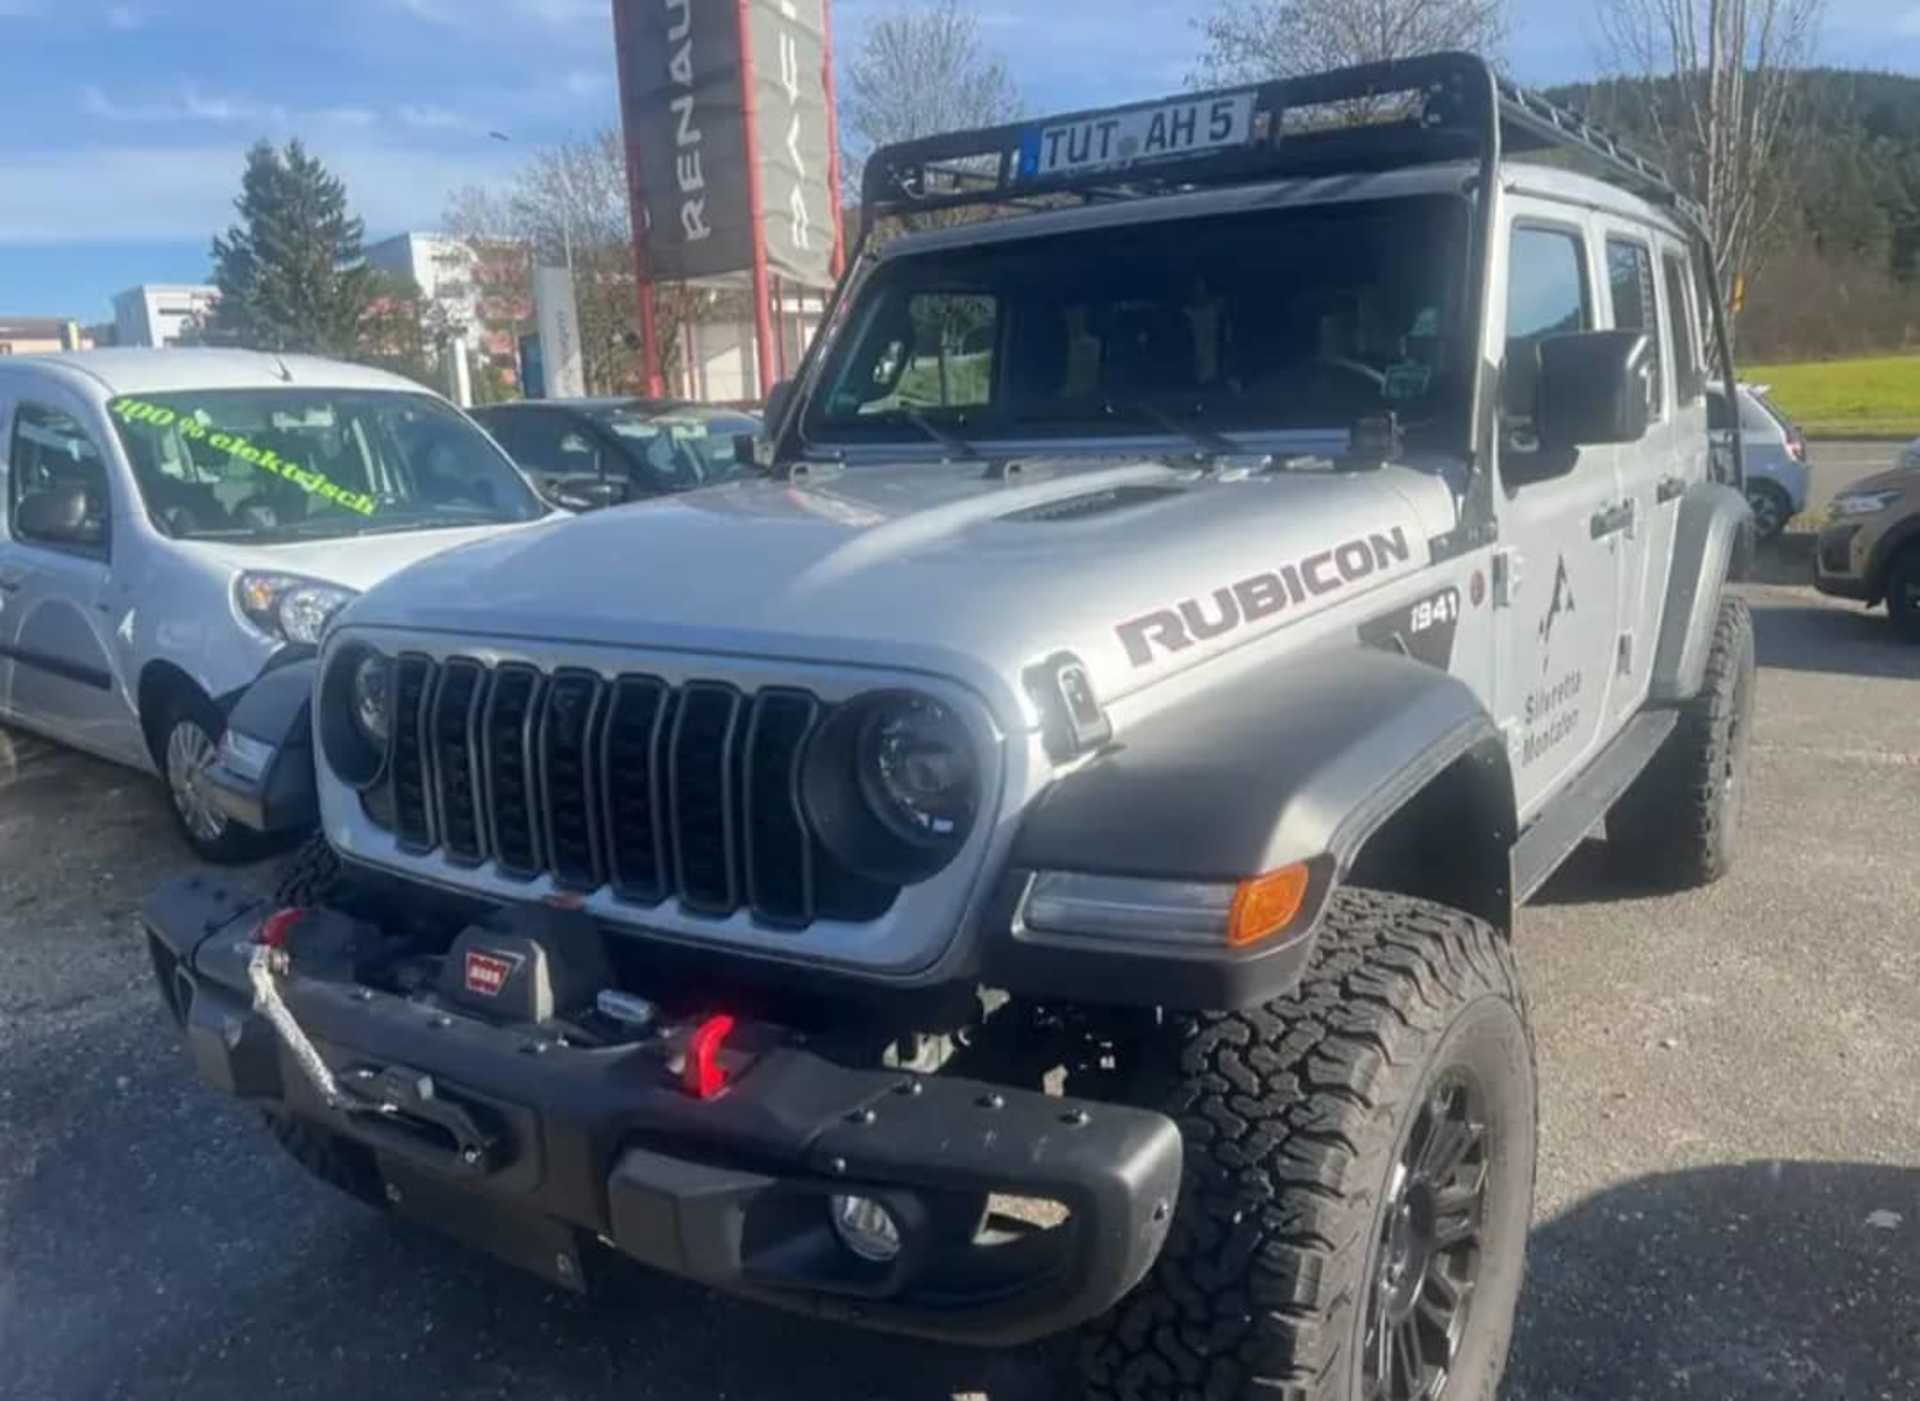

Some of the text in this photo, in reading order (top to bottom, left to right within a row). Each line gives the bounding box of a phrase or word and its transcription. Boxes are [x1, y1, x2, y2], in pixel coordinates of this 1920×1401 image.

[1045, 102, 1235, 168] TUT AH 5
[1115, 526, 1409, 667] RUBICON
[1411, 590, 1458, 633] 1941
